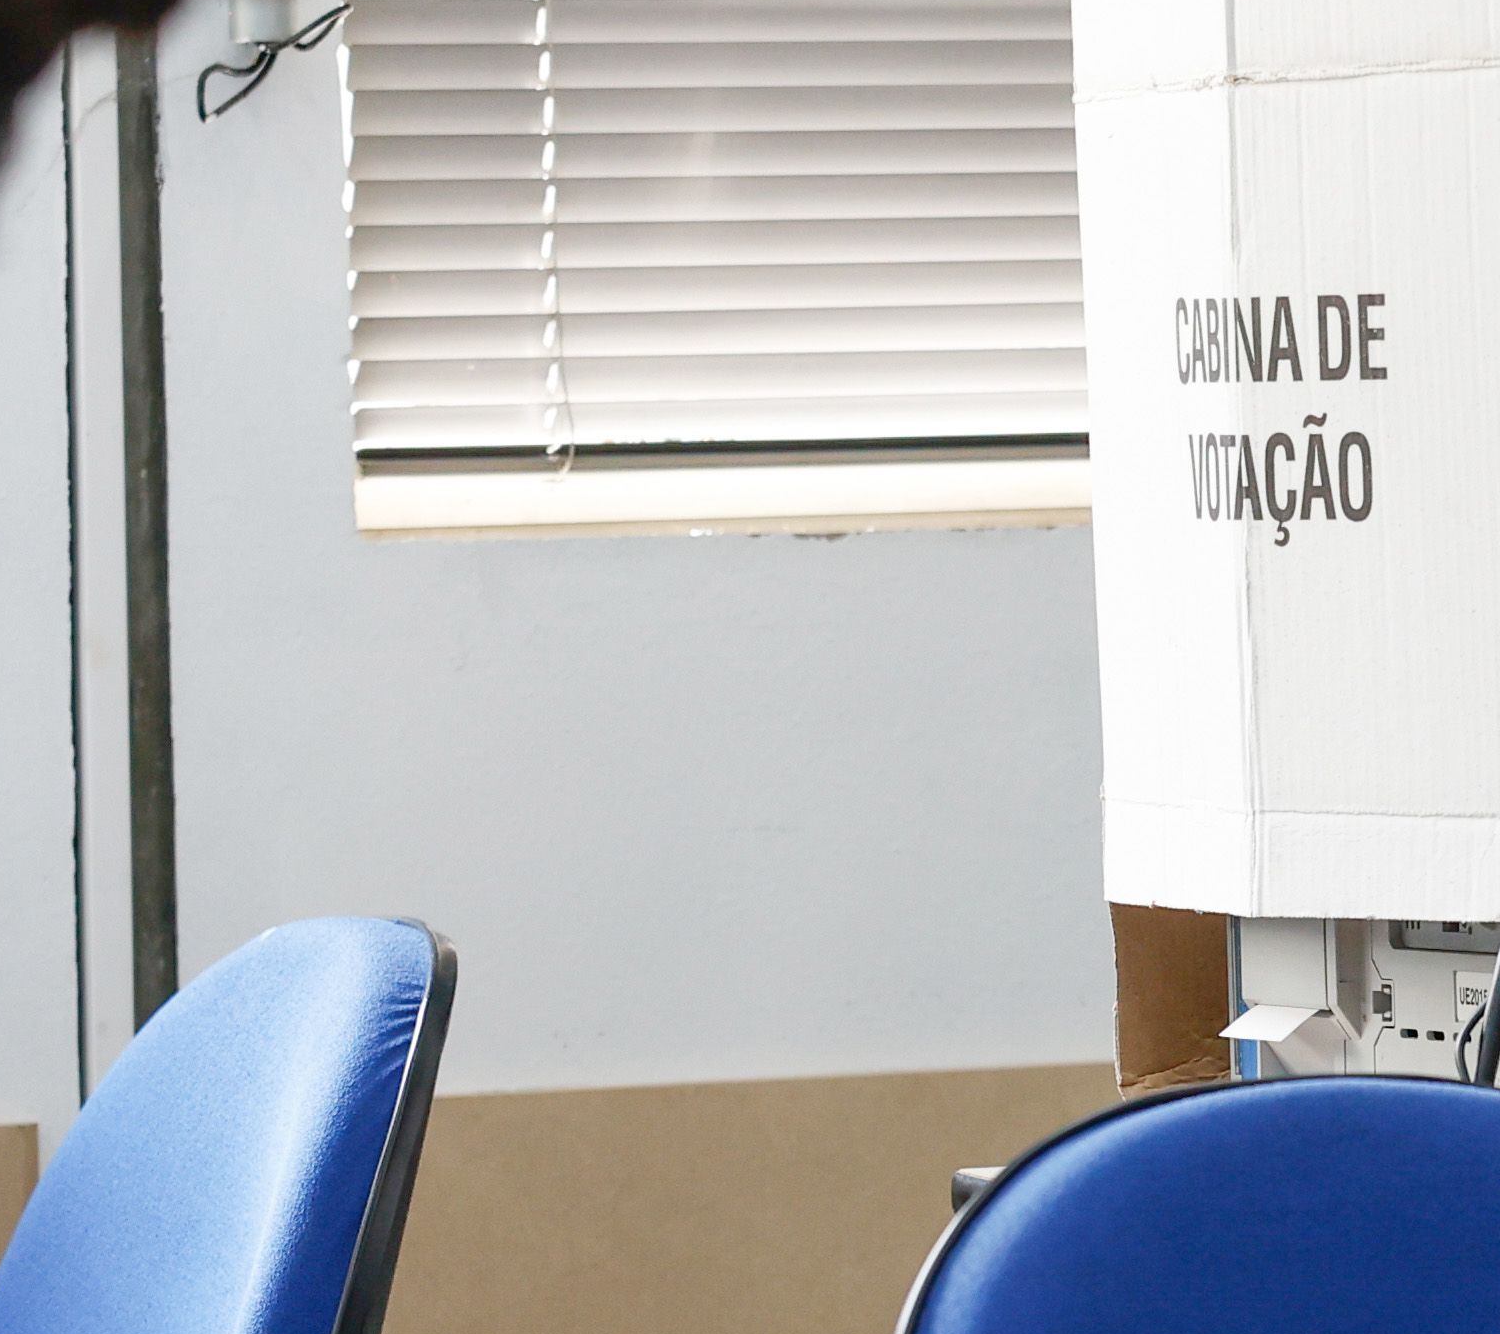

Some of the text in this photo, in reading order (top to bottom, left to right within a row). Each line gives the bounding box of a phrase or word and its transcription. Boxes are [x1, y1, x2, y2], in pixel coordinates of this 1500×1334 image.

[1176, 293, 1388, 384] CABINA DE
[1189, 412, 1373, 547] VOTAÇÃO
